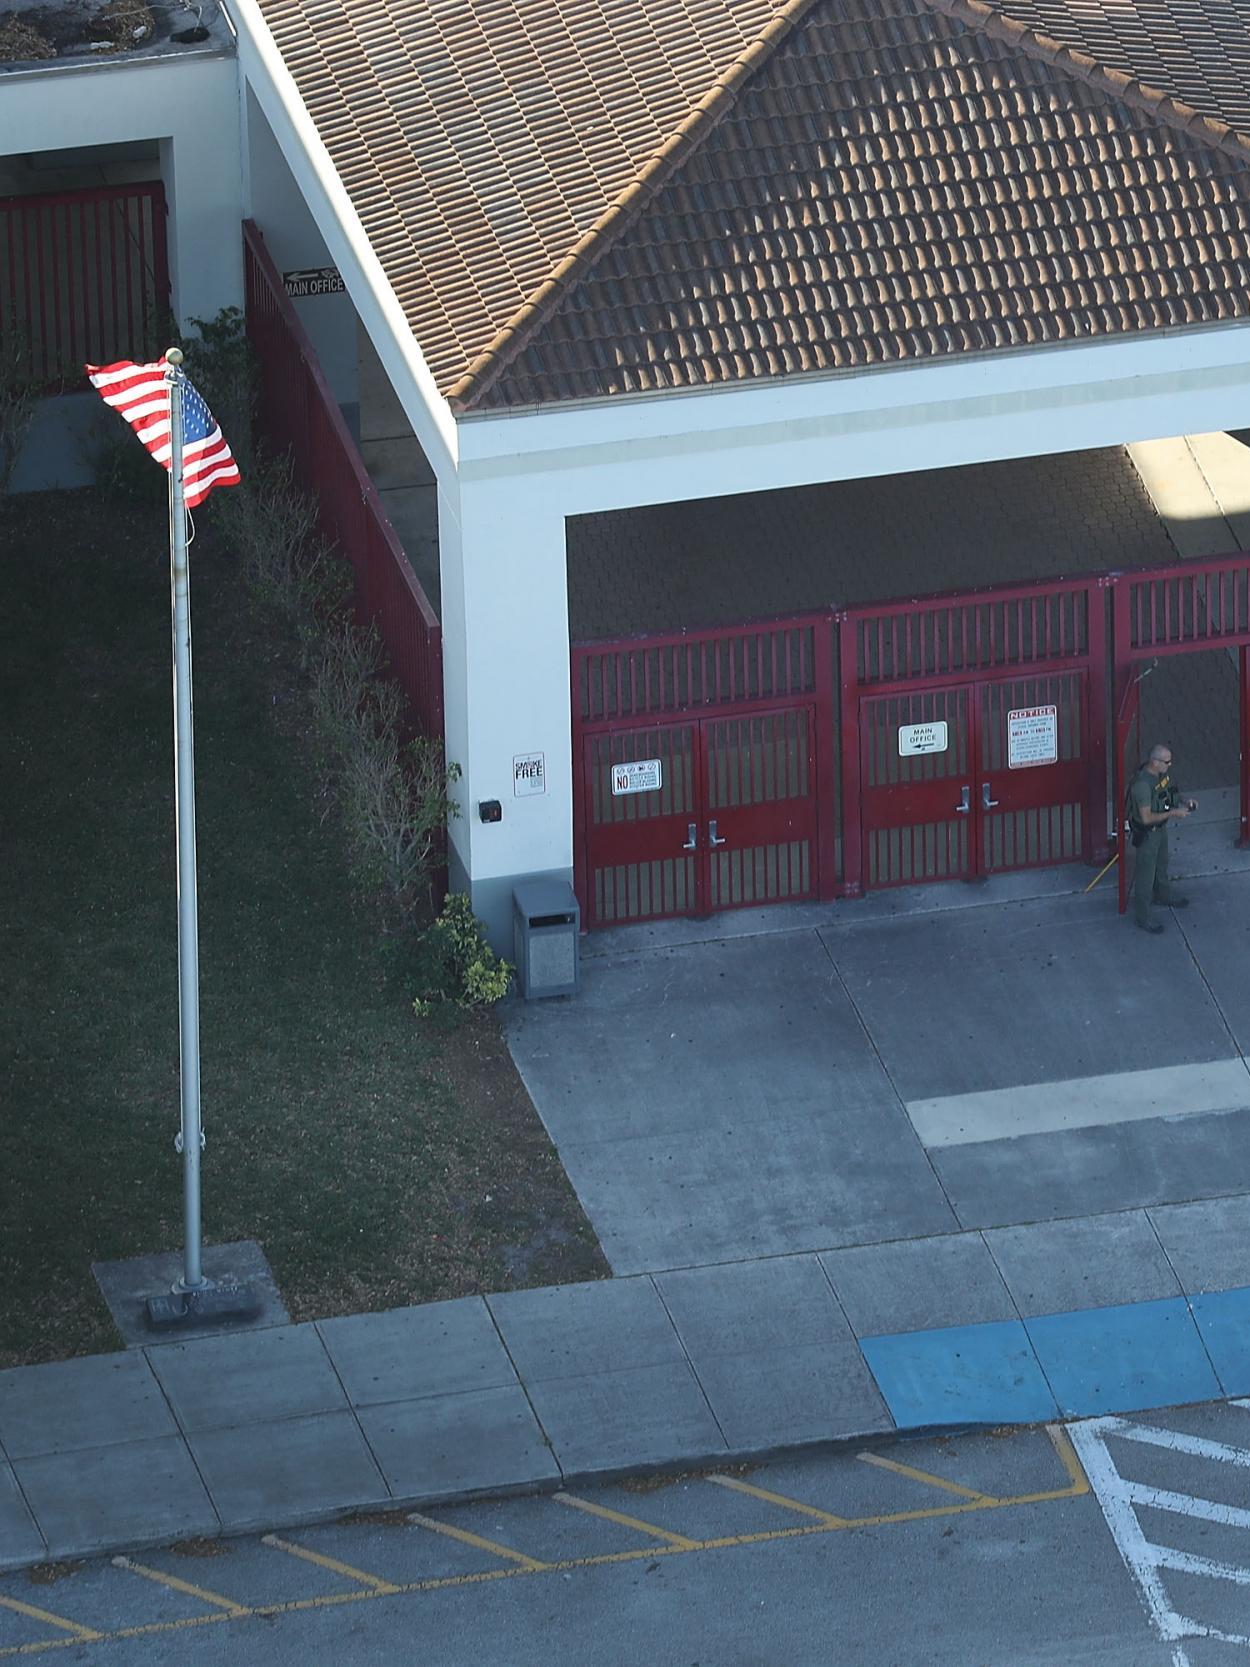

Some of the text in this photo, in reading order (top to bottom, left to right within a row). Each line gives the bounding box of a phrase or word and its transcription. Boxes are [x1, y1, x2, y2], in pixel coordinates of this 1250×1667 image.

[285, 278, 343, 296] MAIN OFFICE
[1010, 707, 1055, 720] NOTICE
[913, 727, 933, 736] MAIN
[909, 734, 936, 744] OFFICE
[515, 767, 543, 780] FREE
[616, 774, 629, 790] NO
